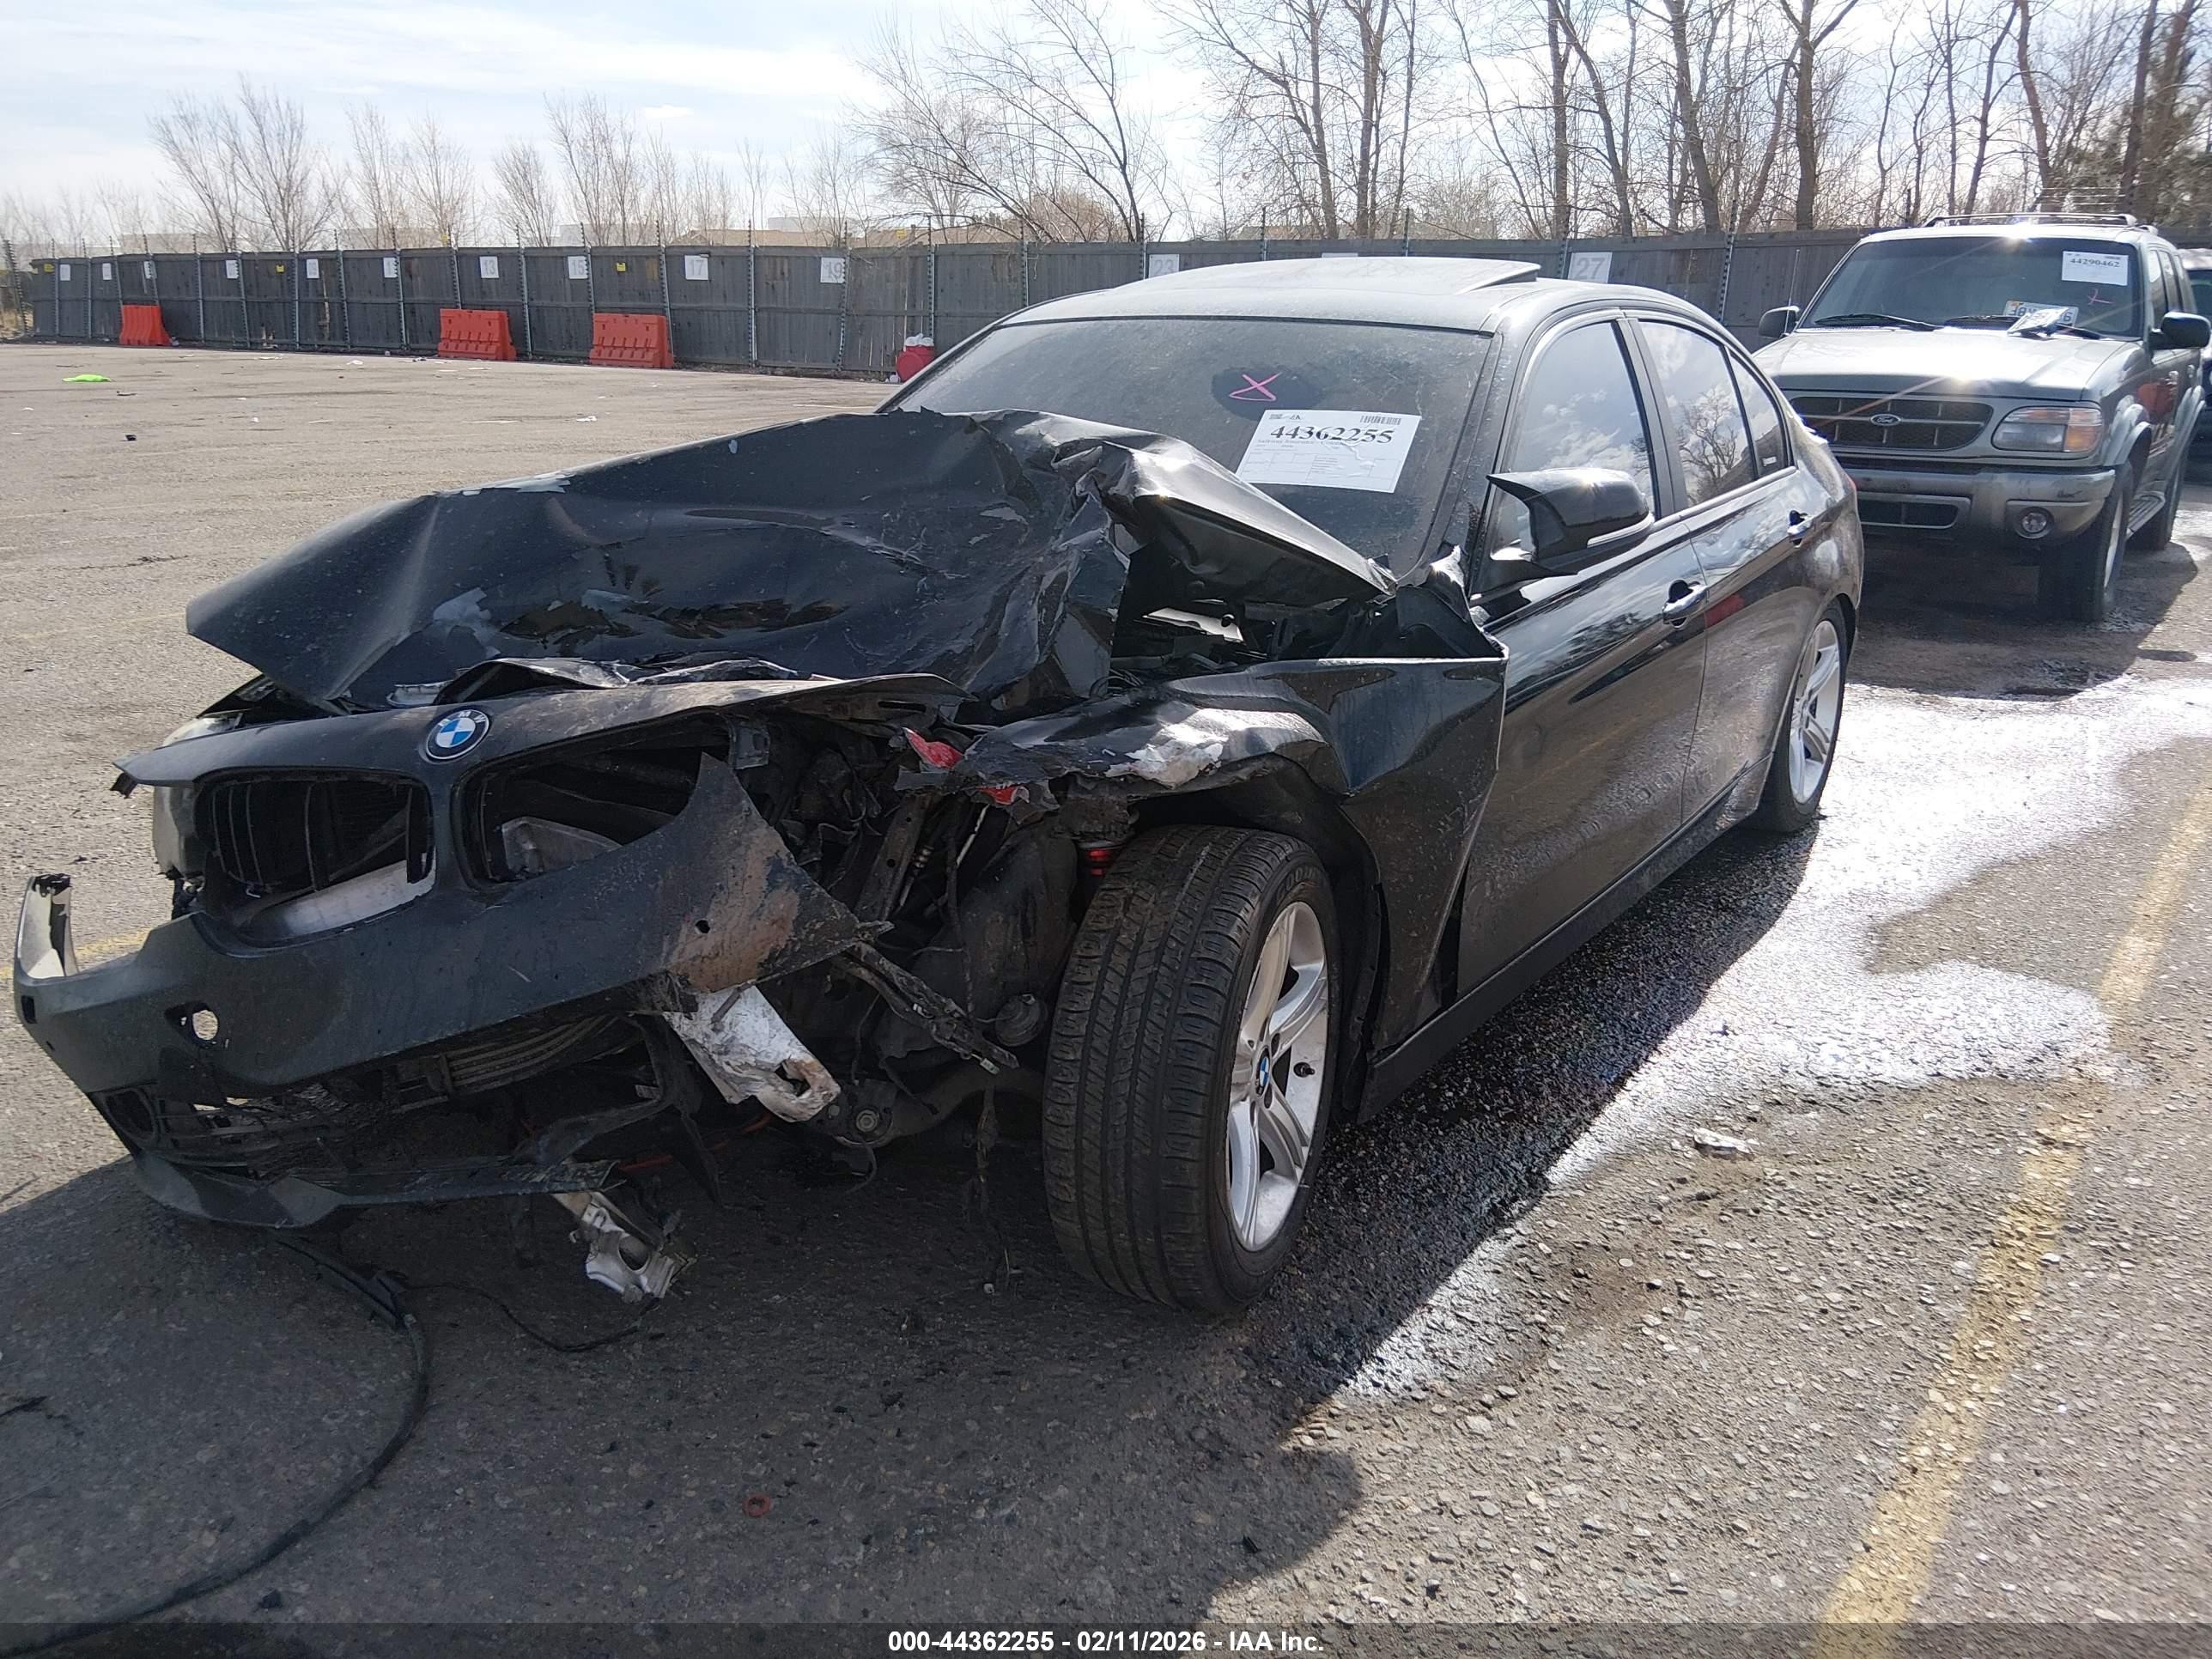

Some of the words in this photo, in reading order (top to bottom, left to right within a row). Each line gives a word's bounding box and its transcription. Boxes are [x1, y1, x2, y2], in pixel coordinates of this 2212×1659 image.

[483, 259, 495, 276] 13
[572, 259, 586, 276] 15
[690, 259, 703, 276] 17
[827, 261, 842, 279] 19
[1153, 258, 1174, 276] 23
[1575, 257, 1606, 280] 27
[1270, 425, 1395, 444] 44362255
